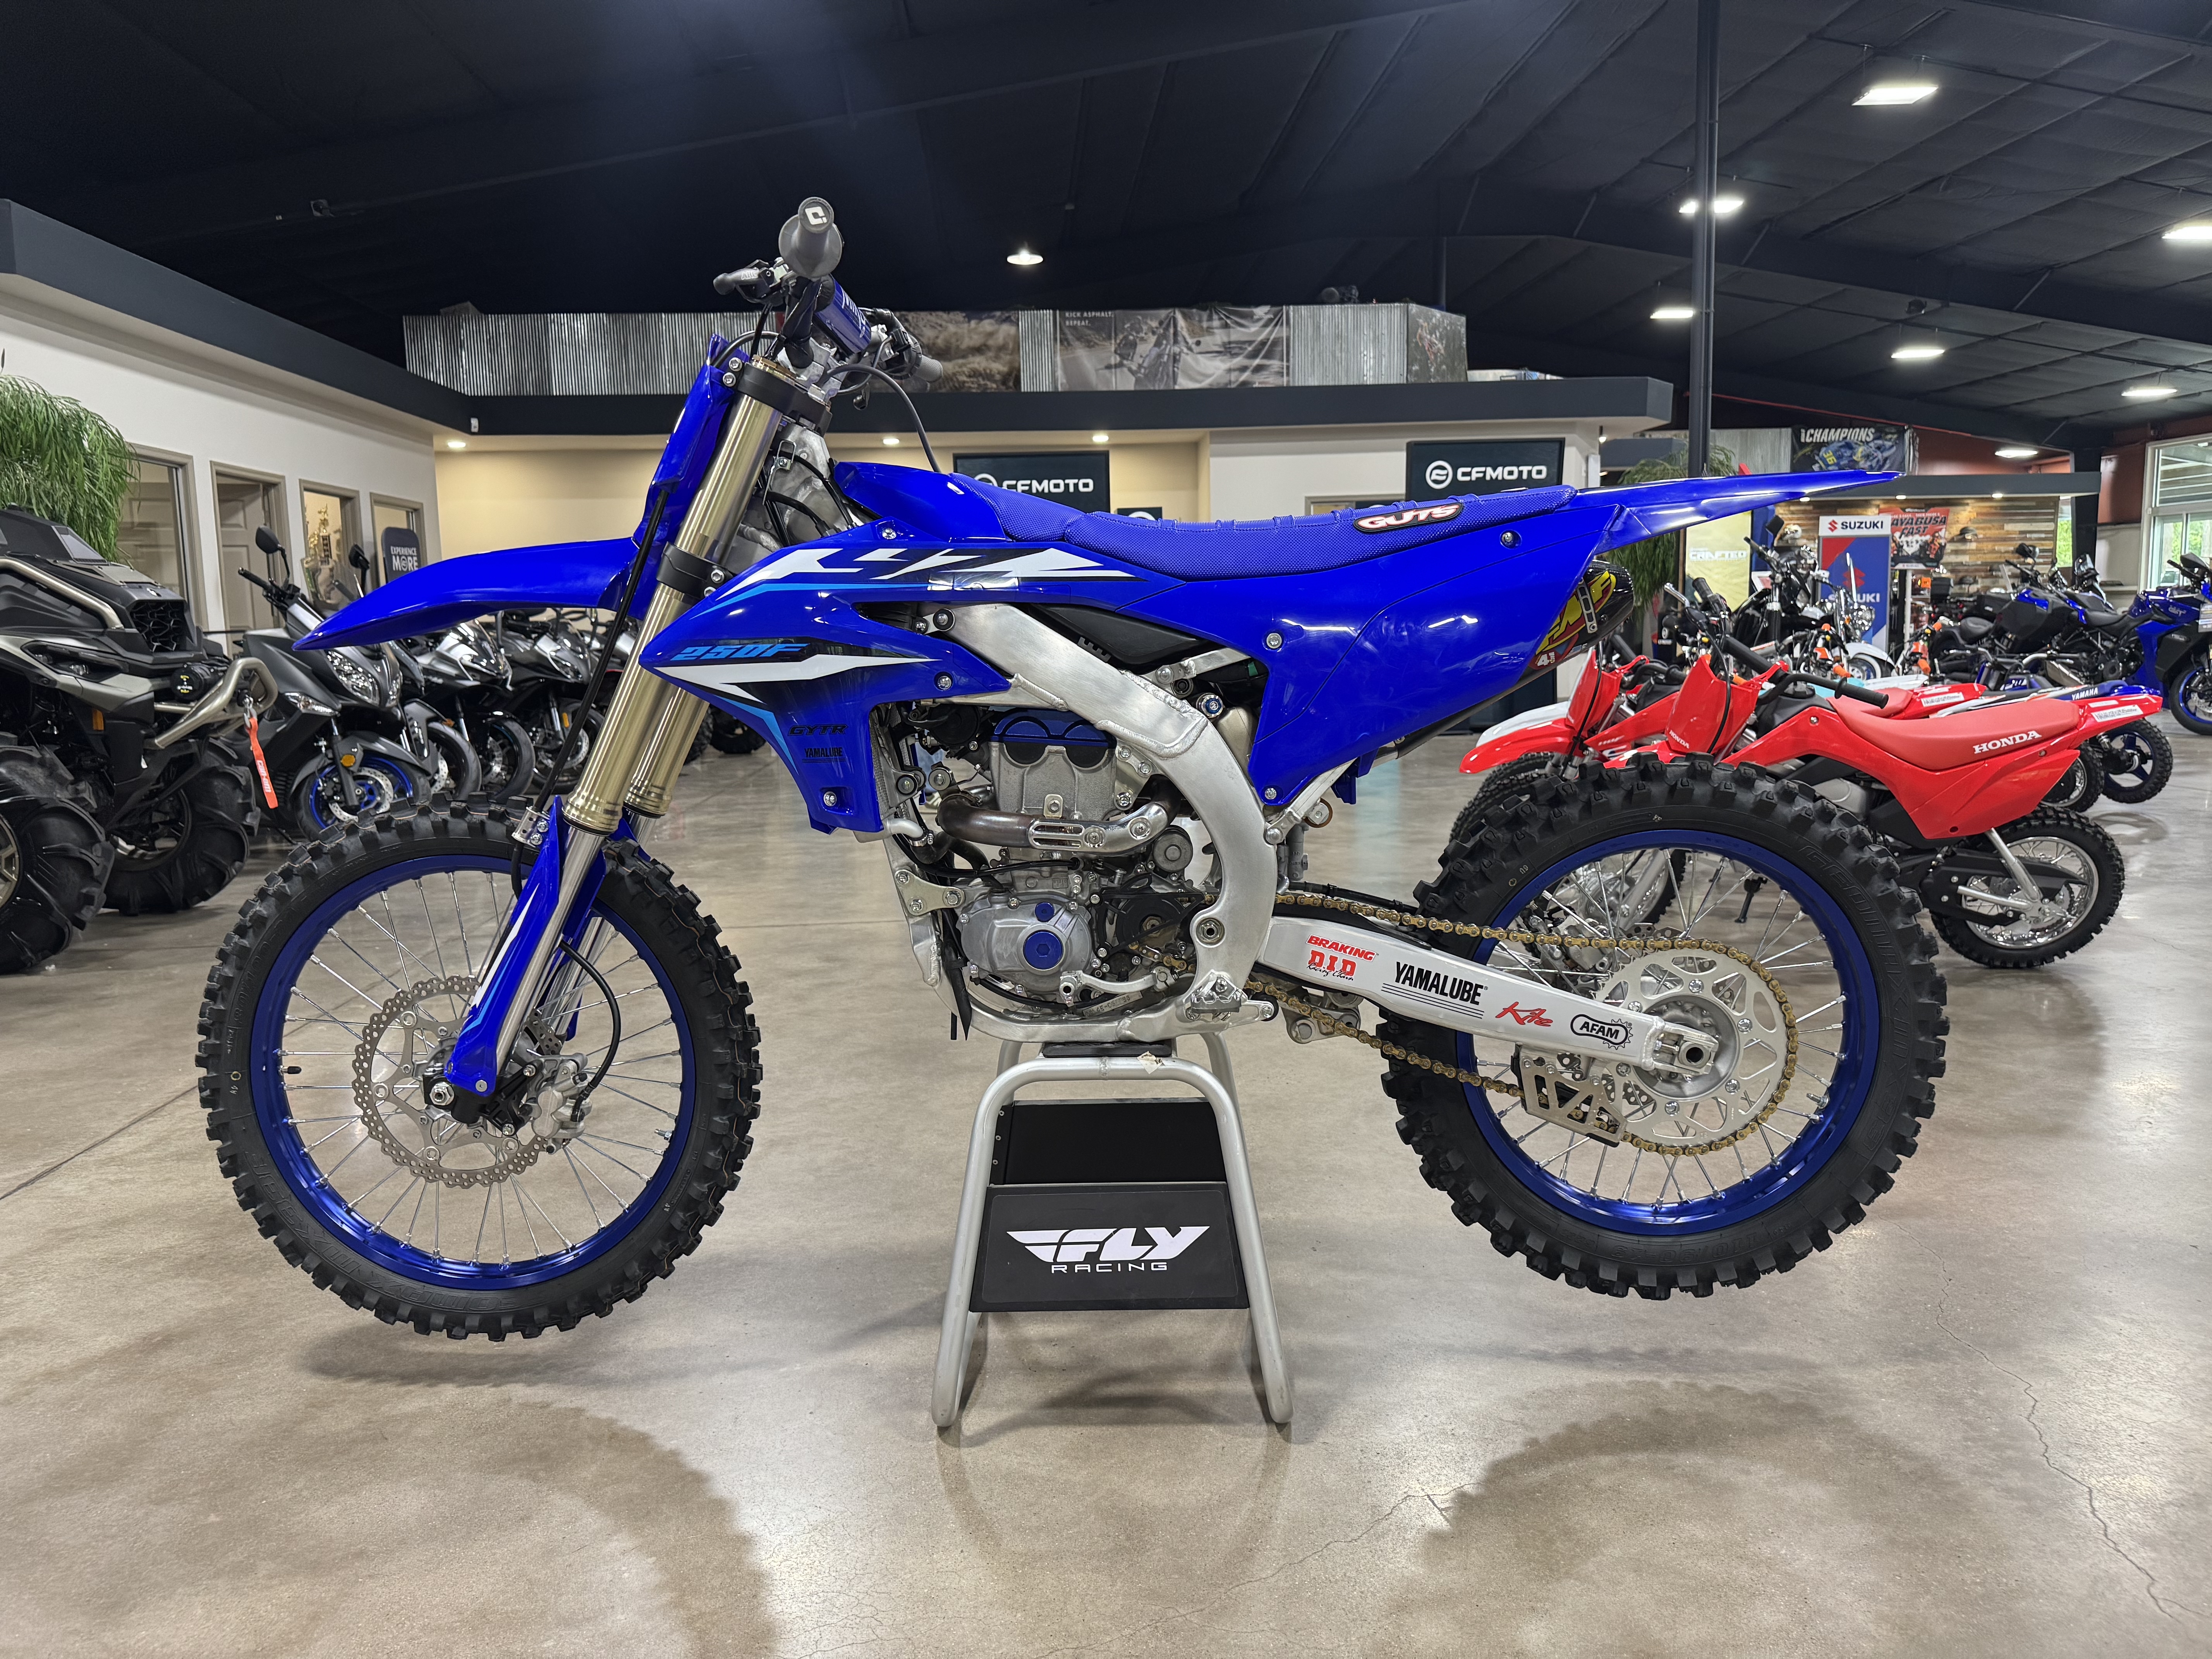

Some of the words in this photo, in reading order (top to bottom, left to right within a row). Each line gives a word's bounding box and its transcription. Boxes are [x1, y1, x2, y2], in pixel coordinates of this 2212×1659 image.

[1805, 427, 1875, 443] CHAMPIONS
[1457, 465, 1547, 481] CFMOTO
[1003, 479, 1094, 493] CFMOTO
[1358, 505, 1460, 529] GUTS
[1841, 520, 1884, 529] SUZUKI
[1891, 516, 1947, 527] AYABUSA
[1899, 526, 1929, 539] FAST
[390, 546, 417, 555] EXPERIENCE
[1828, 593, 1880, 603] SUKI
[670, 643, 810, 661] 250F
[2072, 687, 2098, 700] YAMAHA
[788, 724, 848, 736] GYTR
[1669, 730, 1689, 749] HONDA
[1973, 730, 2042, 754] HONDA
[804, 746, 843, 759] YAMALUBE
[1307, 935, 1376, 961] BRAKING
[1395, 961, 1485, 1005] YAMALUBE
[1495, 1001, 1553, 1027] Kite
[1580, 1021, 1620, 1040] AFAM
[1055, 1226, 1210, 1262] FLY
[1051, 1261, 1169, 1273] RACING
